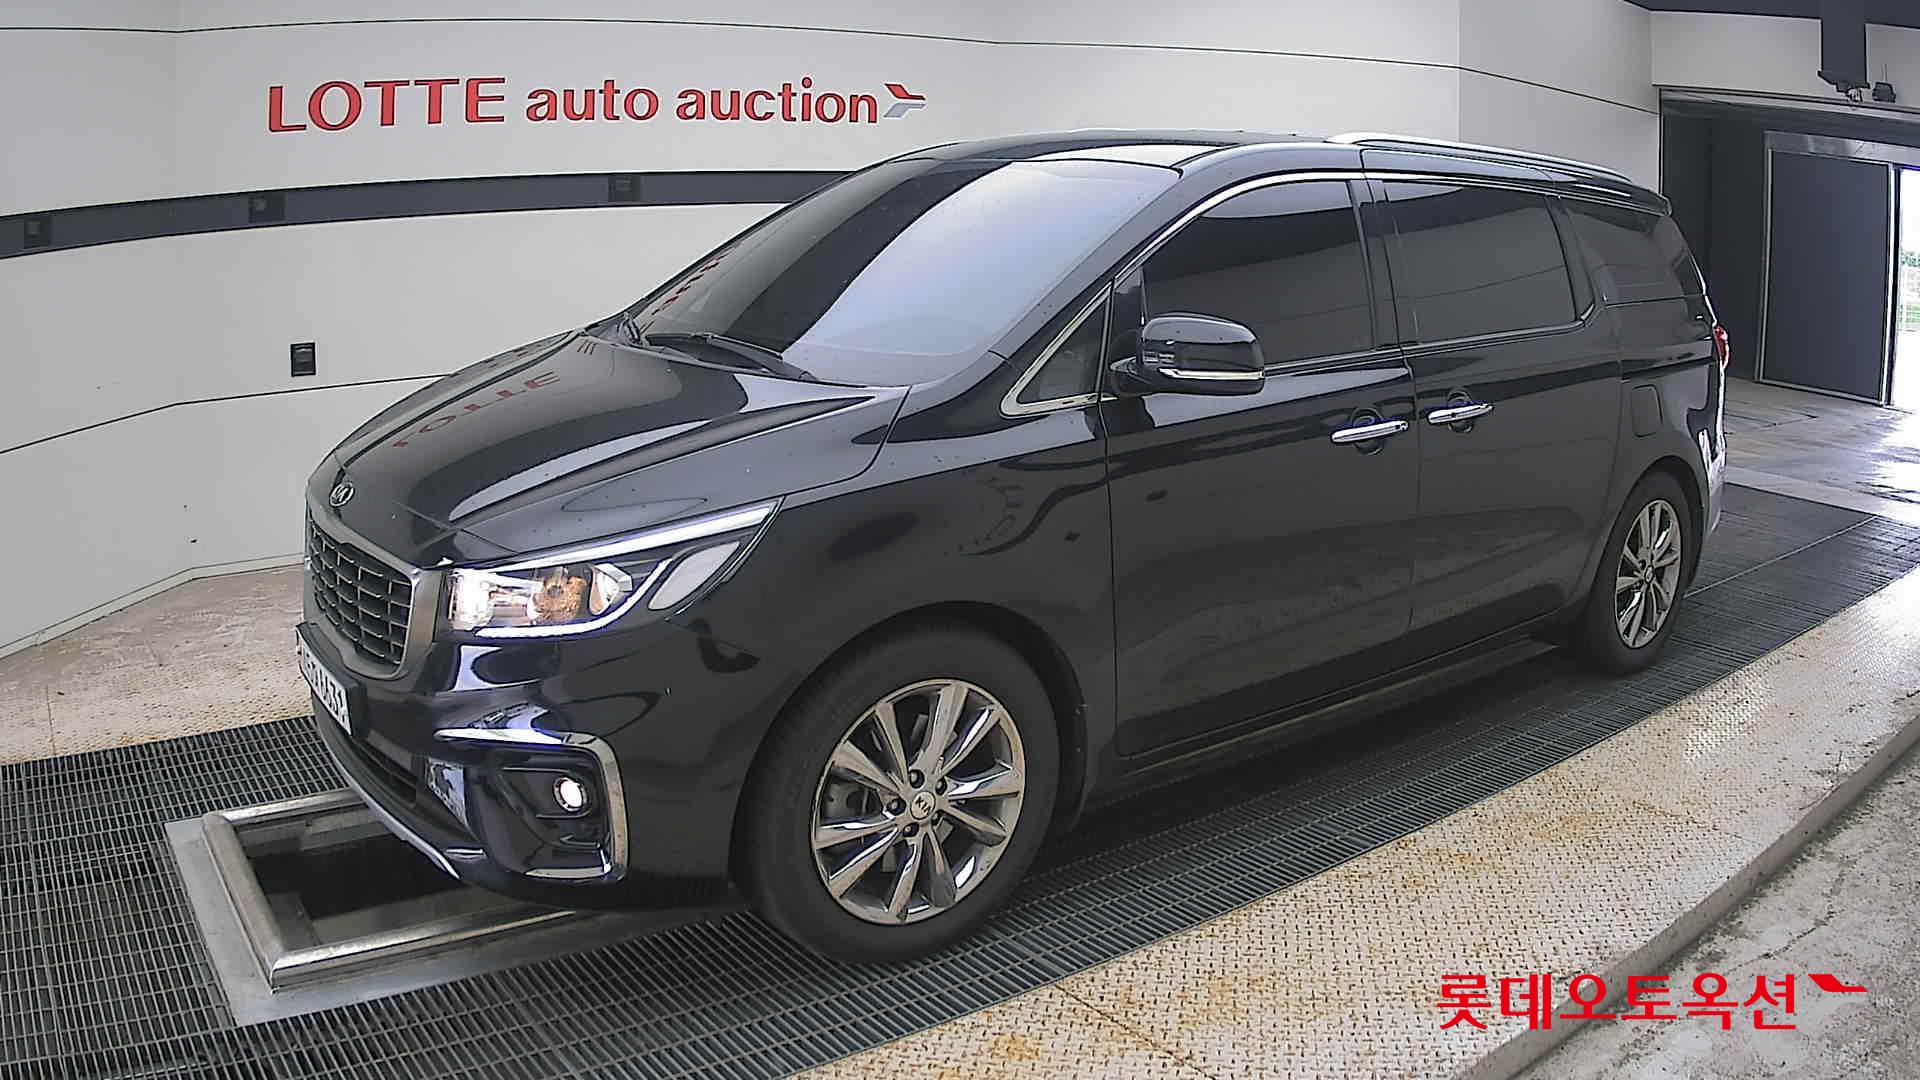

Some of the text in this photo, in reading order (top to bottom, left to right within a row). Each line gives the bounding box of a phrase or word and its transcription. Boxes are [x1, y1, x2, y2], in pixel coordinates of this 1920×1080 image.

[268, 76, 879, 133] LOTTE auto auction
